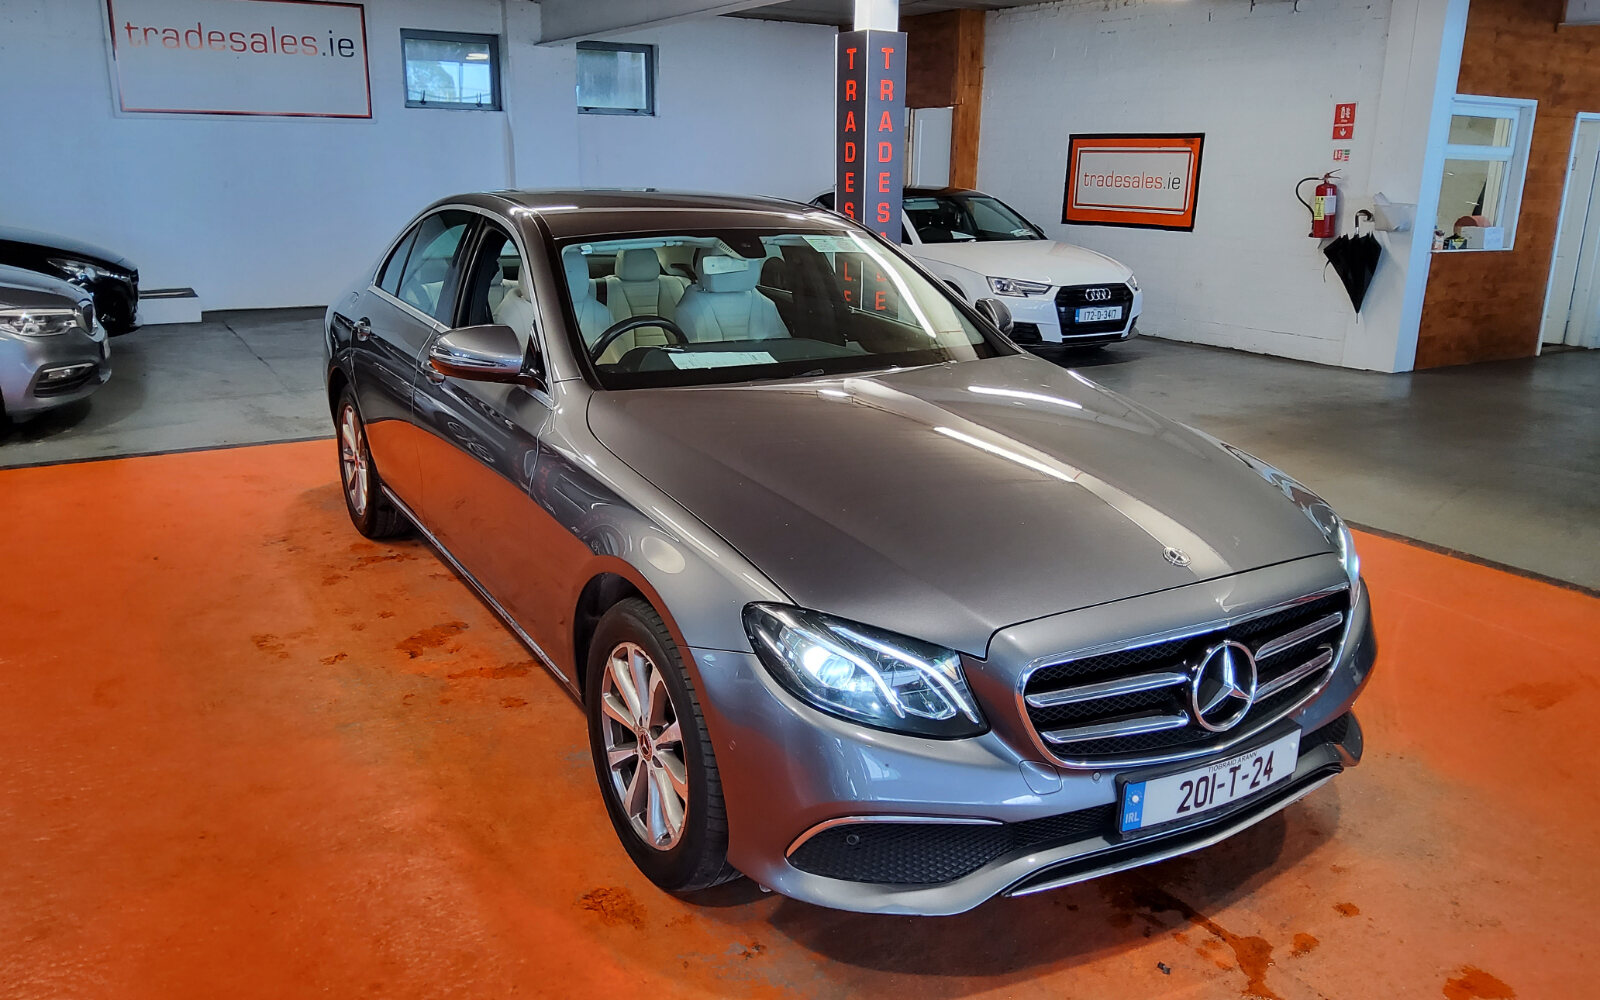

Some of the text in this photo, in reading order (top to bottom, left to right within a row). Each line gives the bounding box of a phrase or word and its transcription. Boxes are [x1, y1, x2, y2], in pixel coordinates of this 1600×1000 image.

[124, 22, 355, 58] tradesales.ie
[1083, 170, 1181, 191] tradesales.ie
[1177, 751, 1274, 813] 201-T-24
[1125, 811, 1140, 824] IRL
